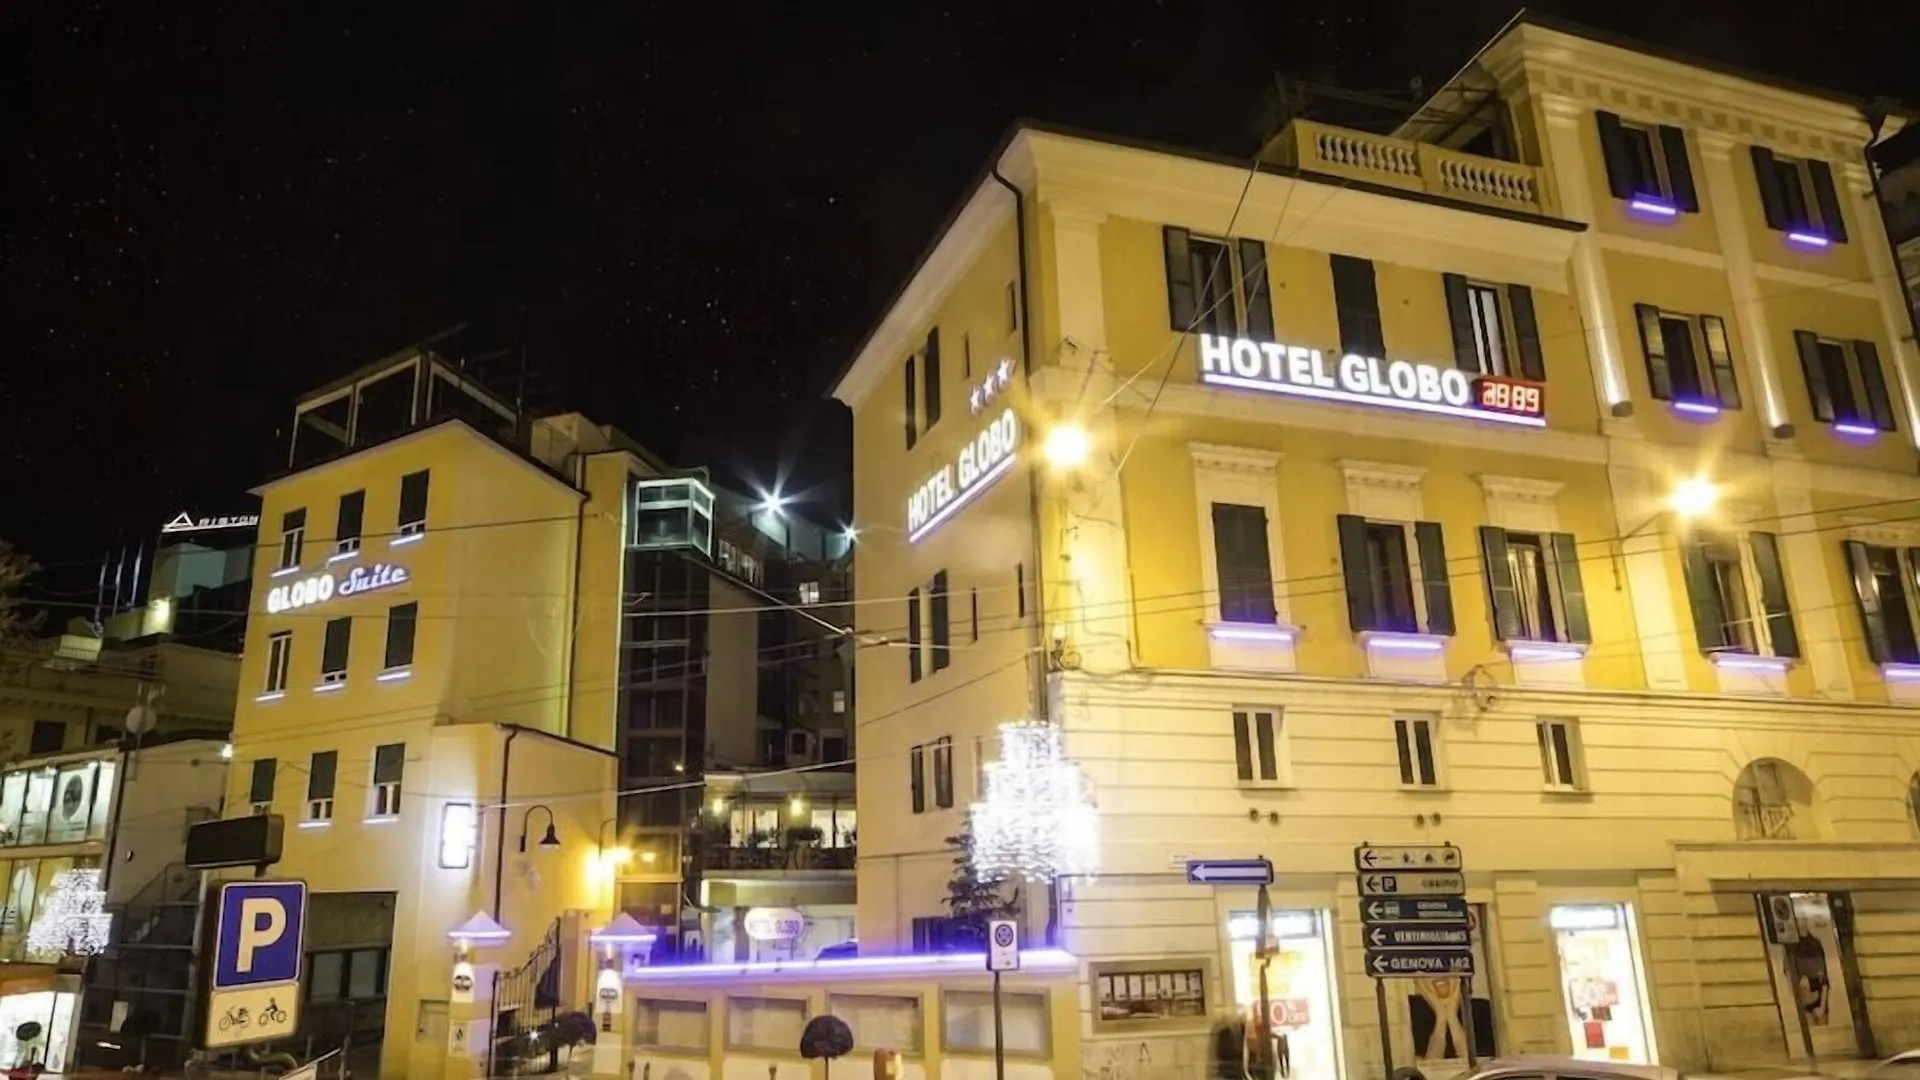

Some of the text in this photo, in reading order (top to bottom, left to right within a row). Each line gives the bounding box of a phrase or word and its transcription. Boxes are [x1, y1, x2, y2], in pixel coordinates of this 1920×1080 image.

[1201, 333, 1470, 406] HOTEL GLOBO
[908, 408, 1016, 532] HOTEL GLOBO
[267, 563, 409, 613] GLOBO Suite
[236, 897, 287, 973] P
[1390, 957, 1443, 970] GENOVA
